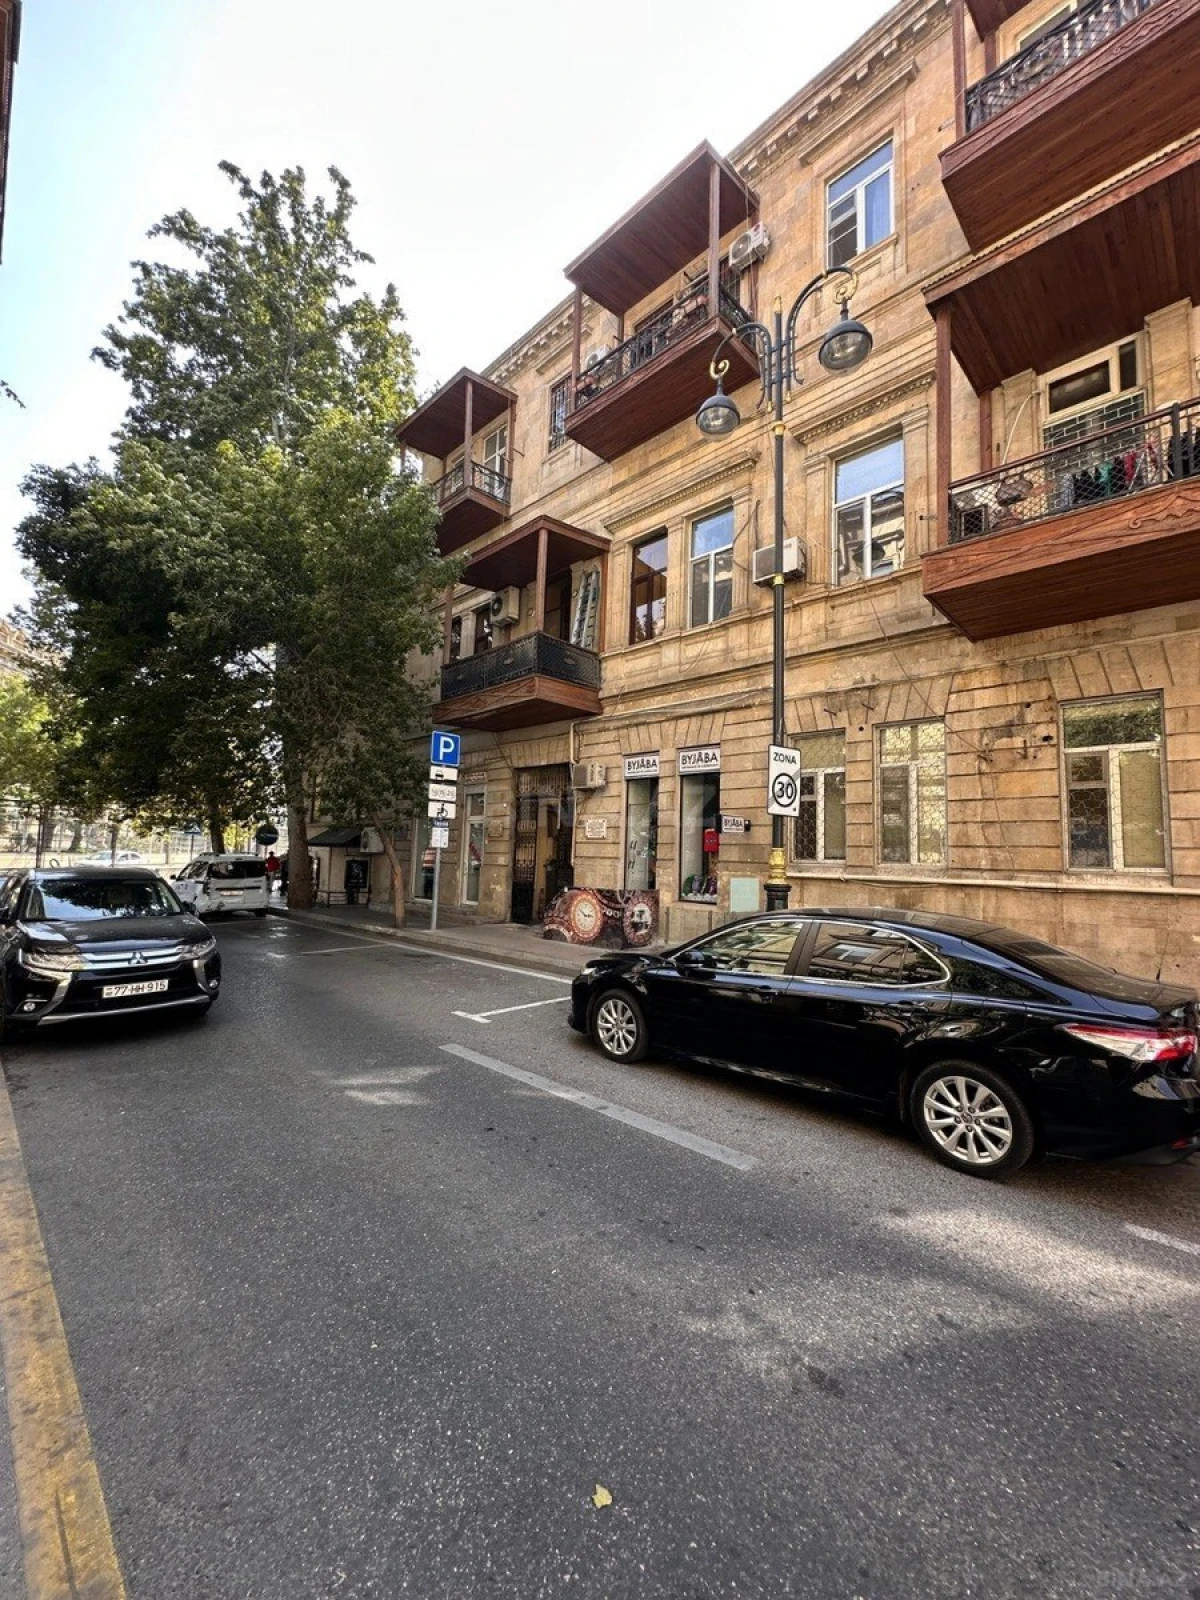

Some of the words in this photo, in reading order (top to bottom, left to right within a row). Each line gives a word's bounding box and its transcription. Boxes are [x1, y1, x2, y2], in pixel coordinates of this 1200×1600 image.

[439, 735, 455, 761] P
[681, 752, 718, 765] BYJÅBA
[773, 752, 797, 764] ZONA
[776, 781, 794, 799] 30
